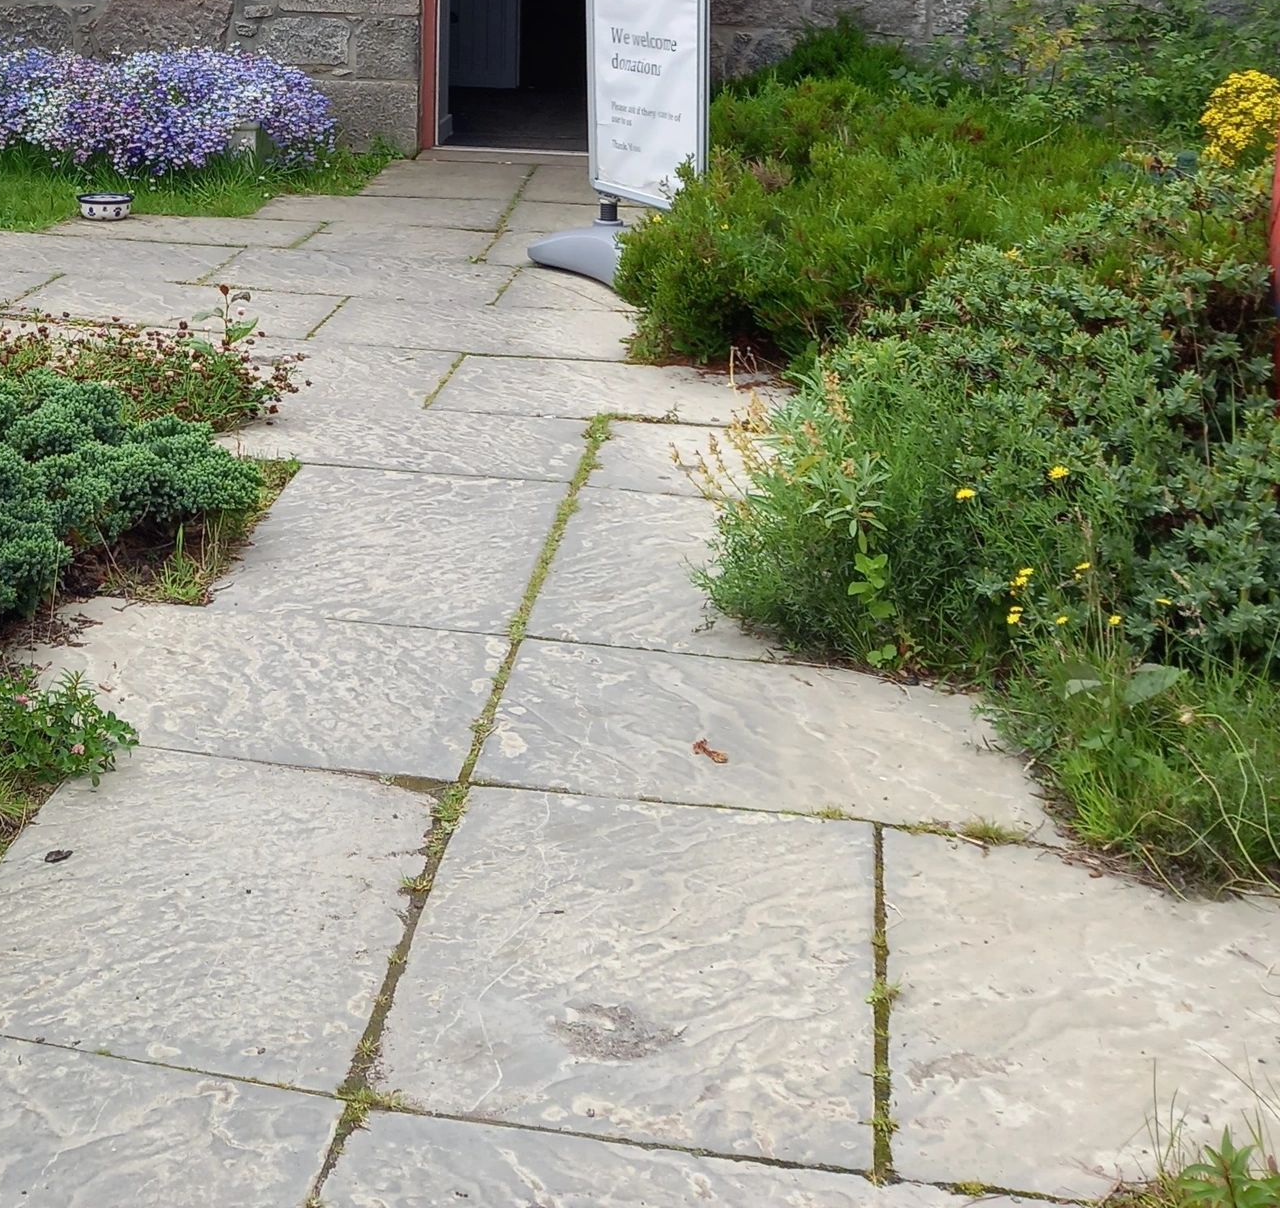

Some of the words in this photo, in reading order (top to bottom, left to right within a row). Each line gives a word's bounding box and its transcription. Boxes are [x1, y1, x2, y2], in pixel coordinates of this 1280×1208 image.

[611, 27, 630, 45] We
[631, 31, 677, 52] welcome
[611, 53, 662, 76] donations
